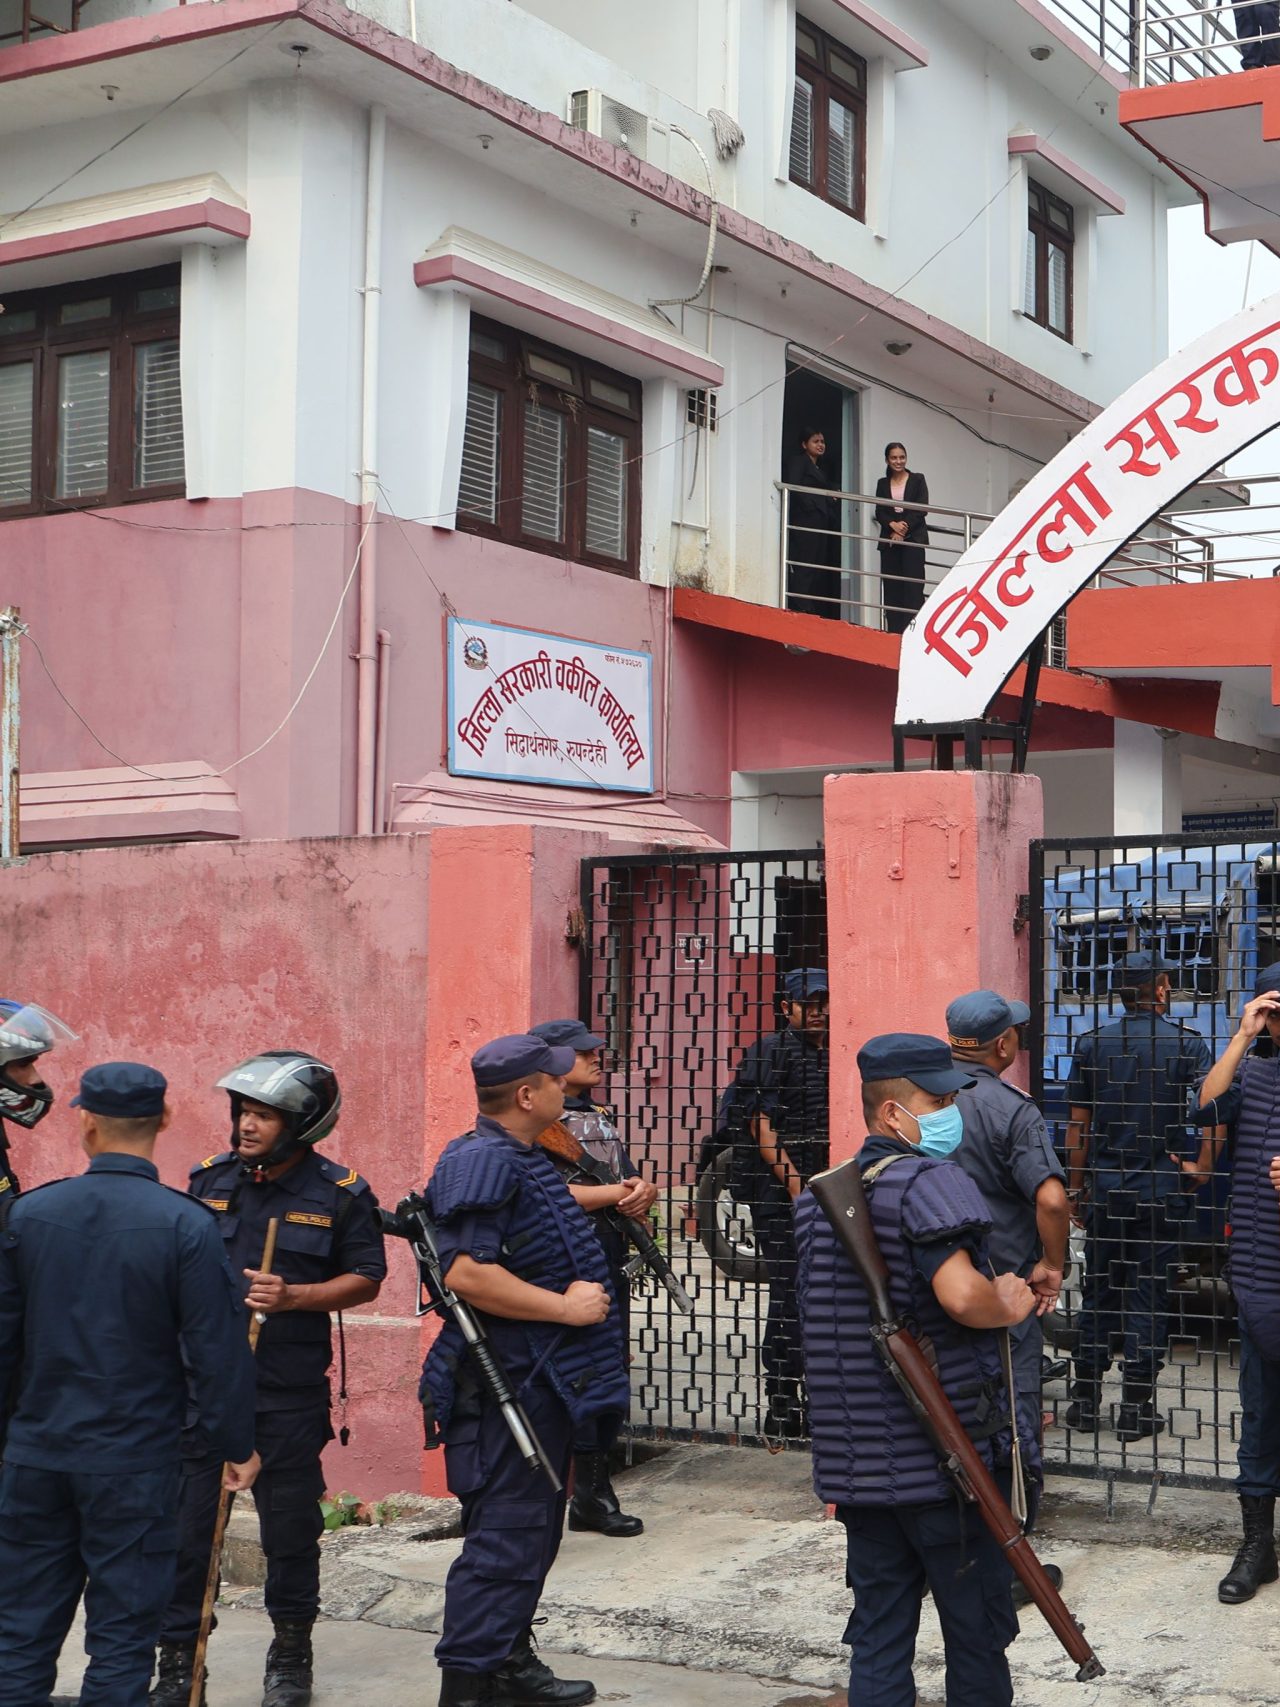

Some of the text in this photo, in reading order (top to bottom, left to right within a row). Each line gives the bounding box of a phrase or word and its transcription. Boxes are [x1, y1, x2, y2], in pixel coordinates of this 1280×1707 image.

[924, 461, 1114, 678] जिल्ला
[457, 650, 645, 770] जिल्ला सरकारी वकील कार्यालय
